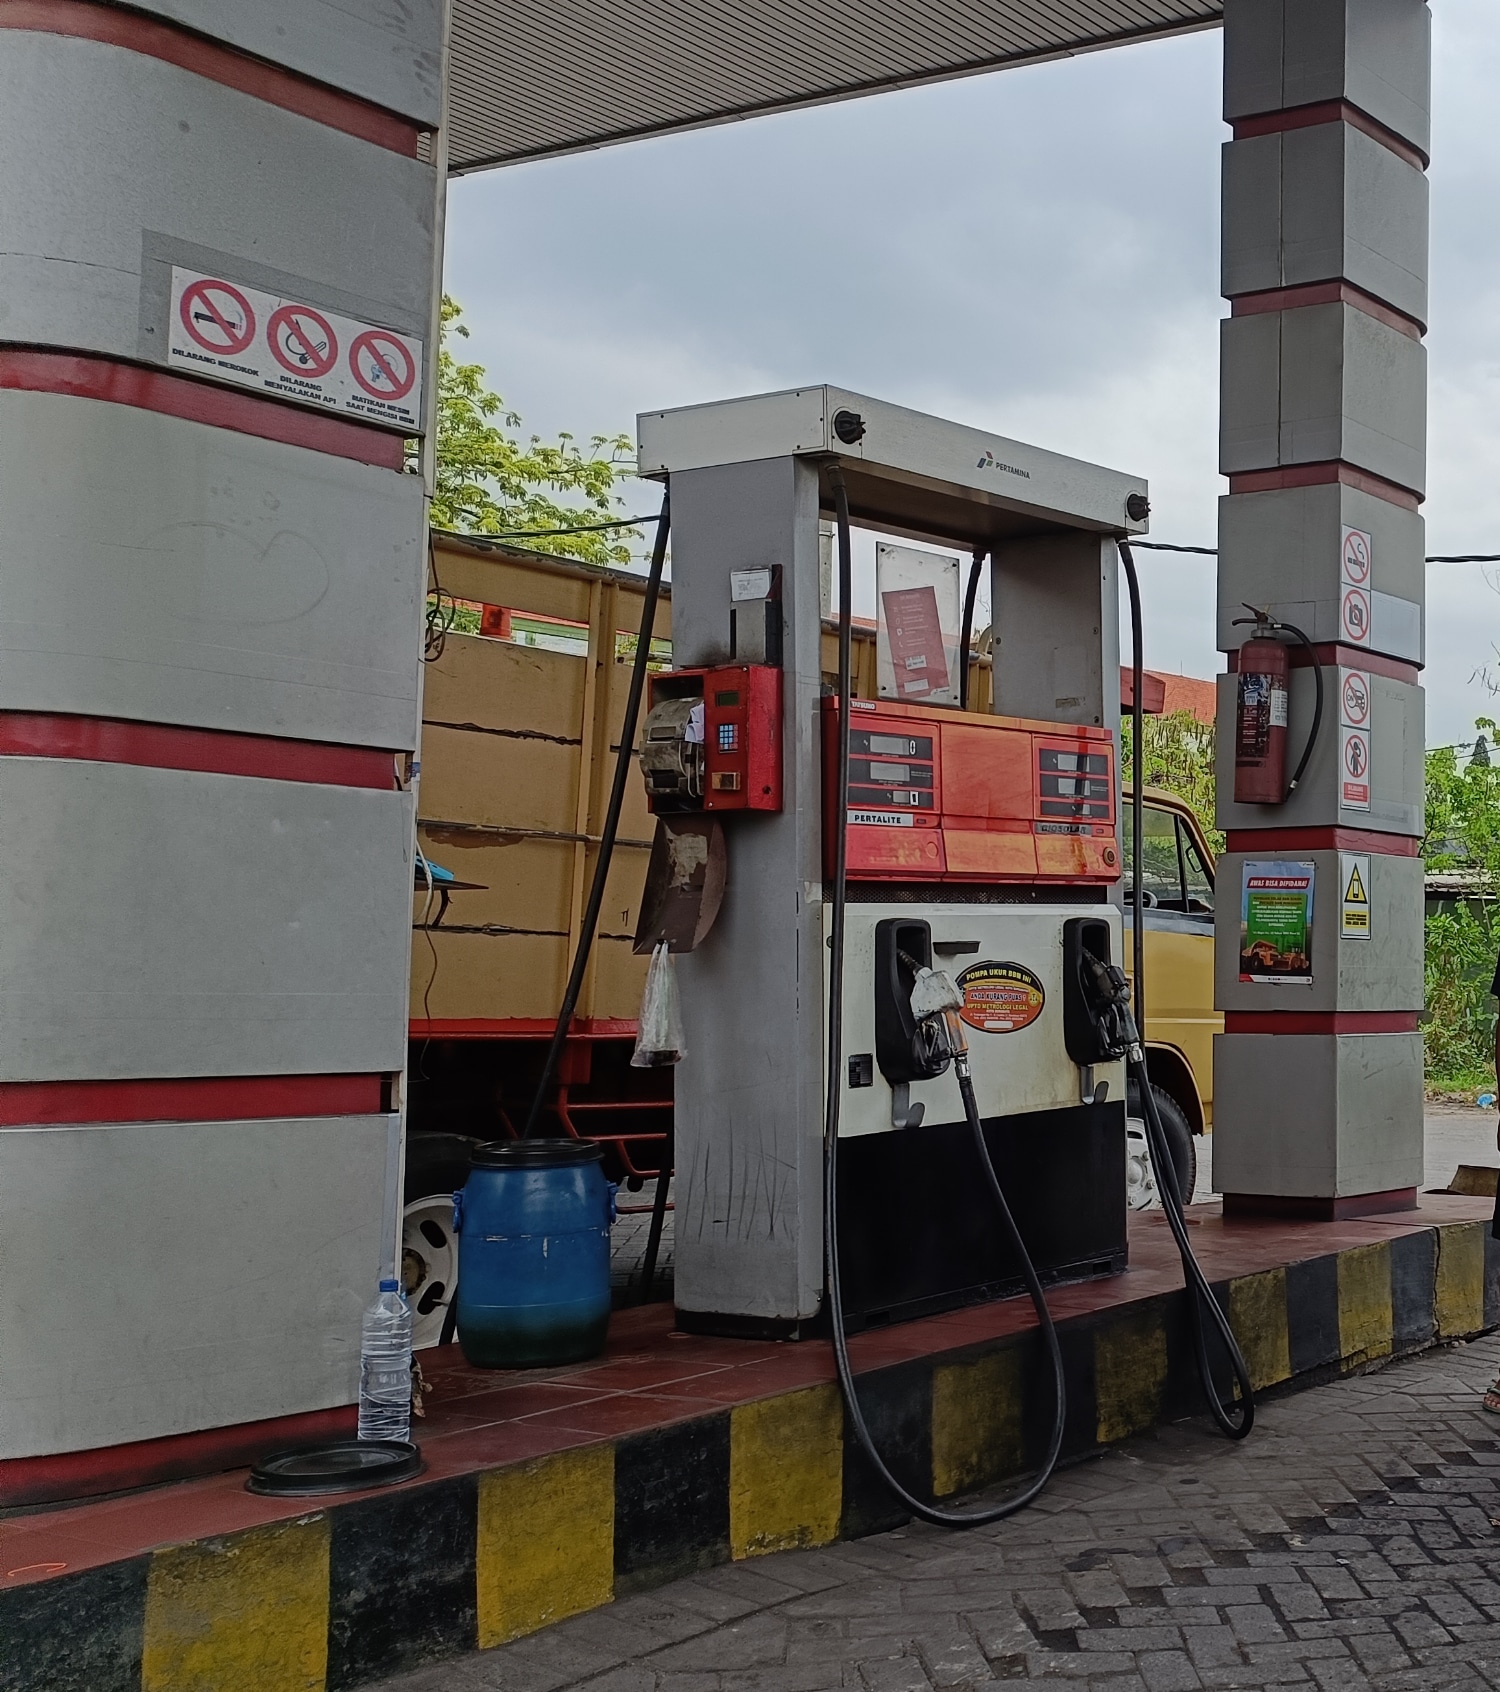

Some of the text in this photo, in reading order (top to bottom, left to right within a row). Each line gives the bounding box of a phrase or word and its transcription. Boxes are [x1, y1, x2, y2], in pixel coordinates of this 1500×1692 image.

[172, 348, 259, 376] DILARANG MEROKOK
[264, 380, 336, 404] MENYALAKAN API
[280, 375, 322, 392] DILARANG
[345, 401, 415, 424] SAAT MENGISI BBM
[352, 395, 410, 415] MATIKAN MESIN
[995, 462, 1031, 479] PERTAMINA
[854, 814, 901, 824] PERTALITE
[966, 968, 1032, 983] POMPA UKUR BBM INI
[970, 992, 985, 1000] ANDA
[986, 993, 1008, 1001] KURANG
[1009, 993, 1021, 1001] PUAS
